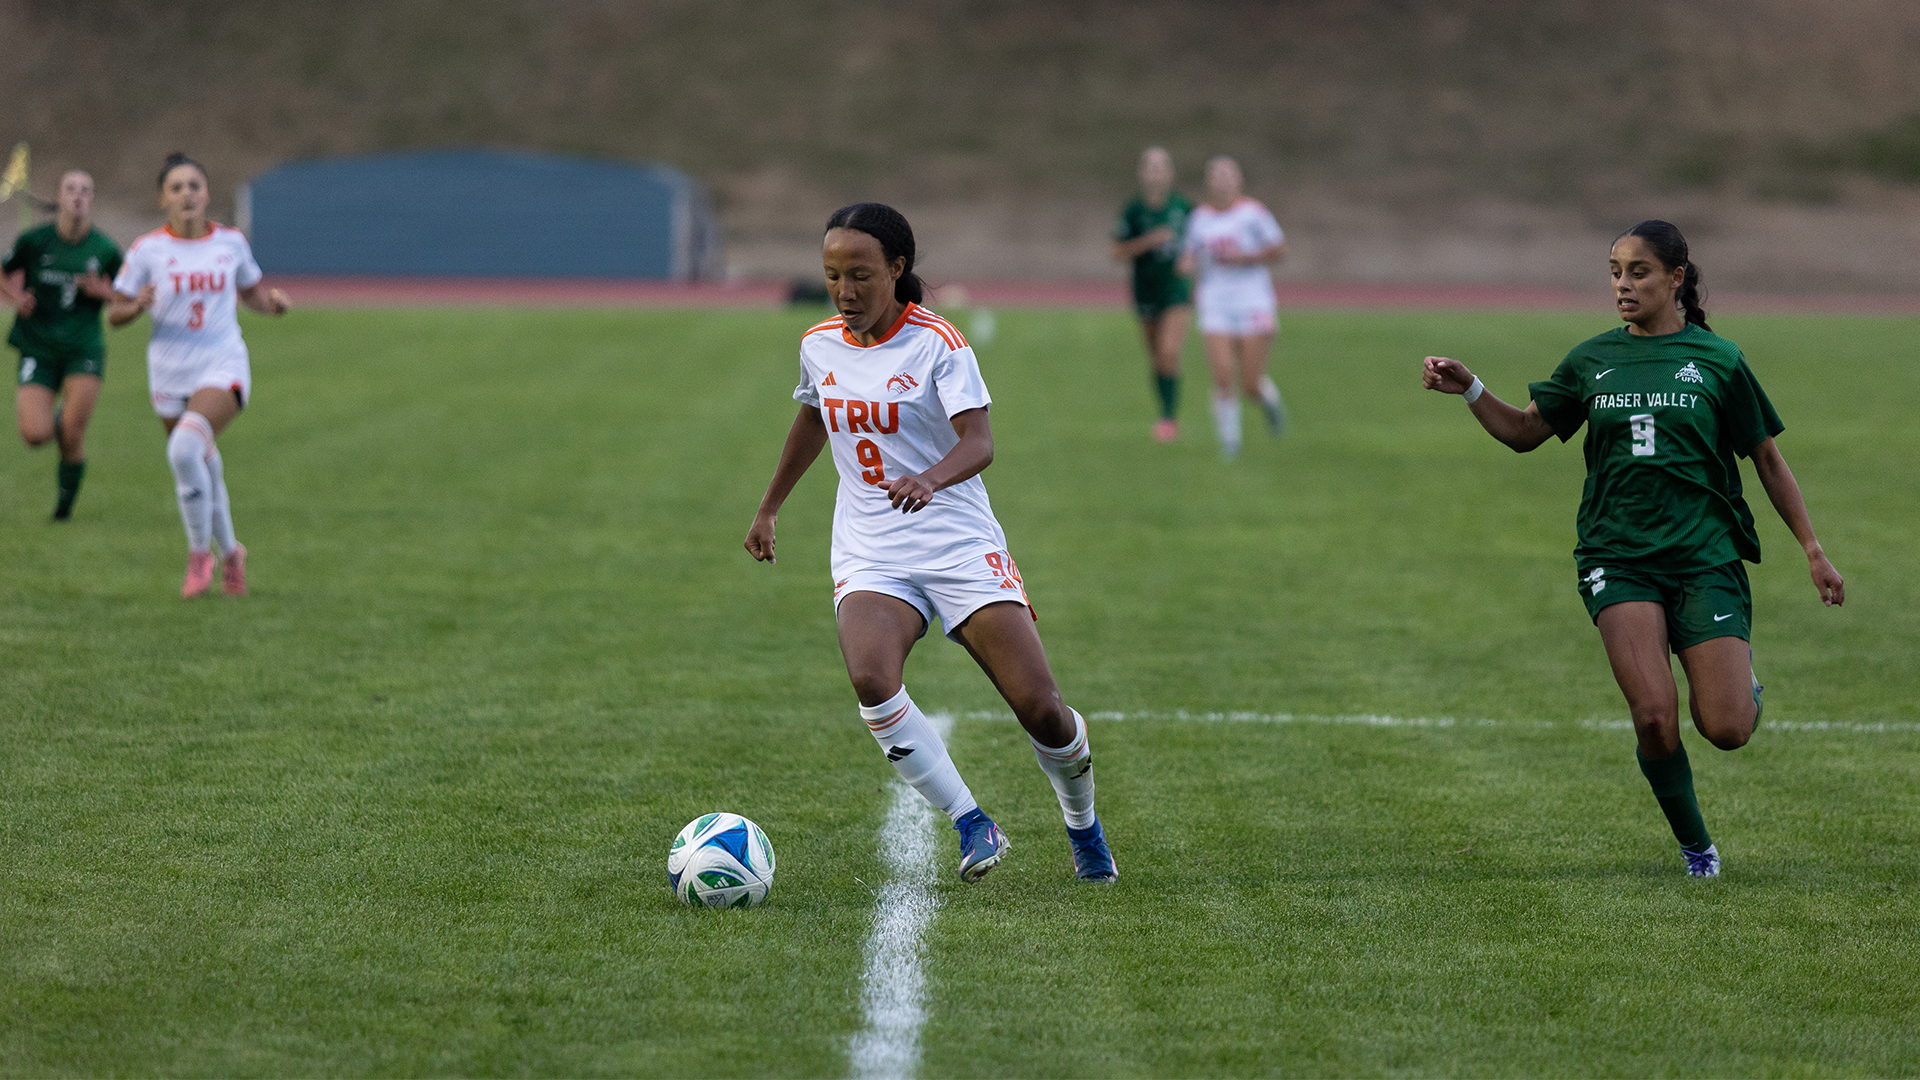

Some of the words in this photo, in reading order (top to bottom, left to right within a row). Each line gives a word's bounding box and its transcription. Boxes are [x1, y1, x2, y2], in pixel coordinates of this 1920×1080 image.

[169, 272, 226, 294] TRU
[187, 301, 205, 331] 3
[824, 397, 899, 434] TRU
[1594, 393, 1641, 409] FRASER
[1646, 393, 1698, 409] VALLEY
[1629, 414, 1656, 456] 9
[856, 439, 885, 485] 9
